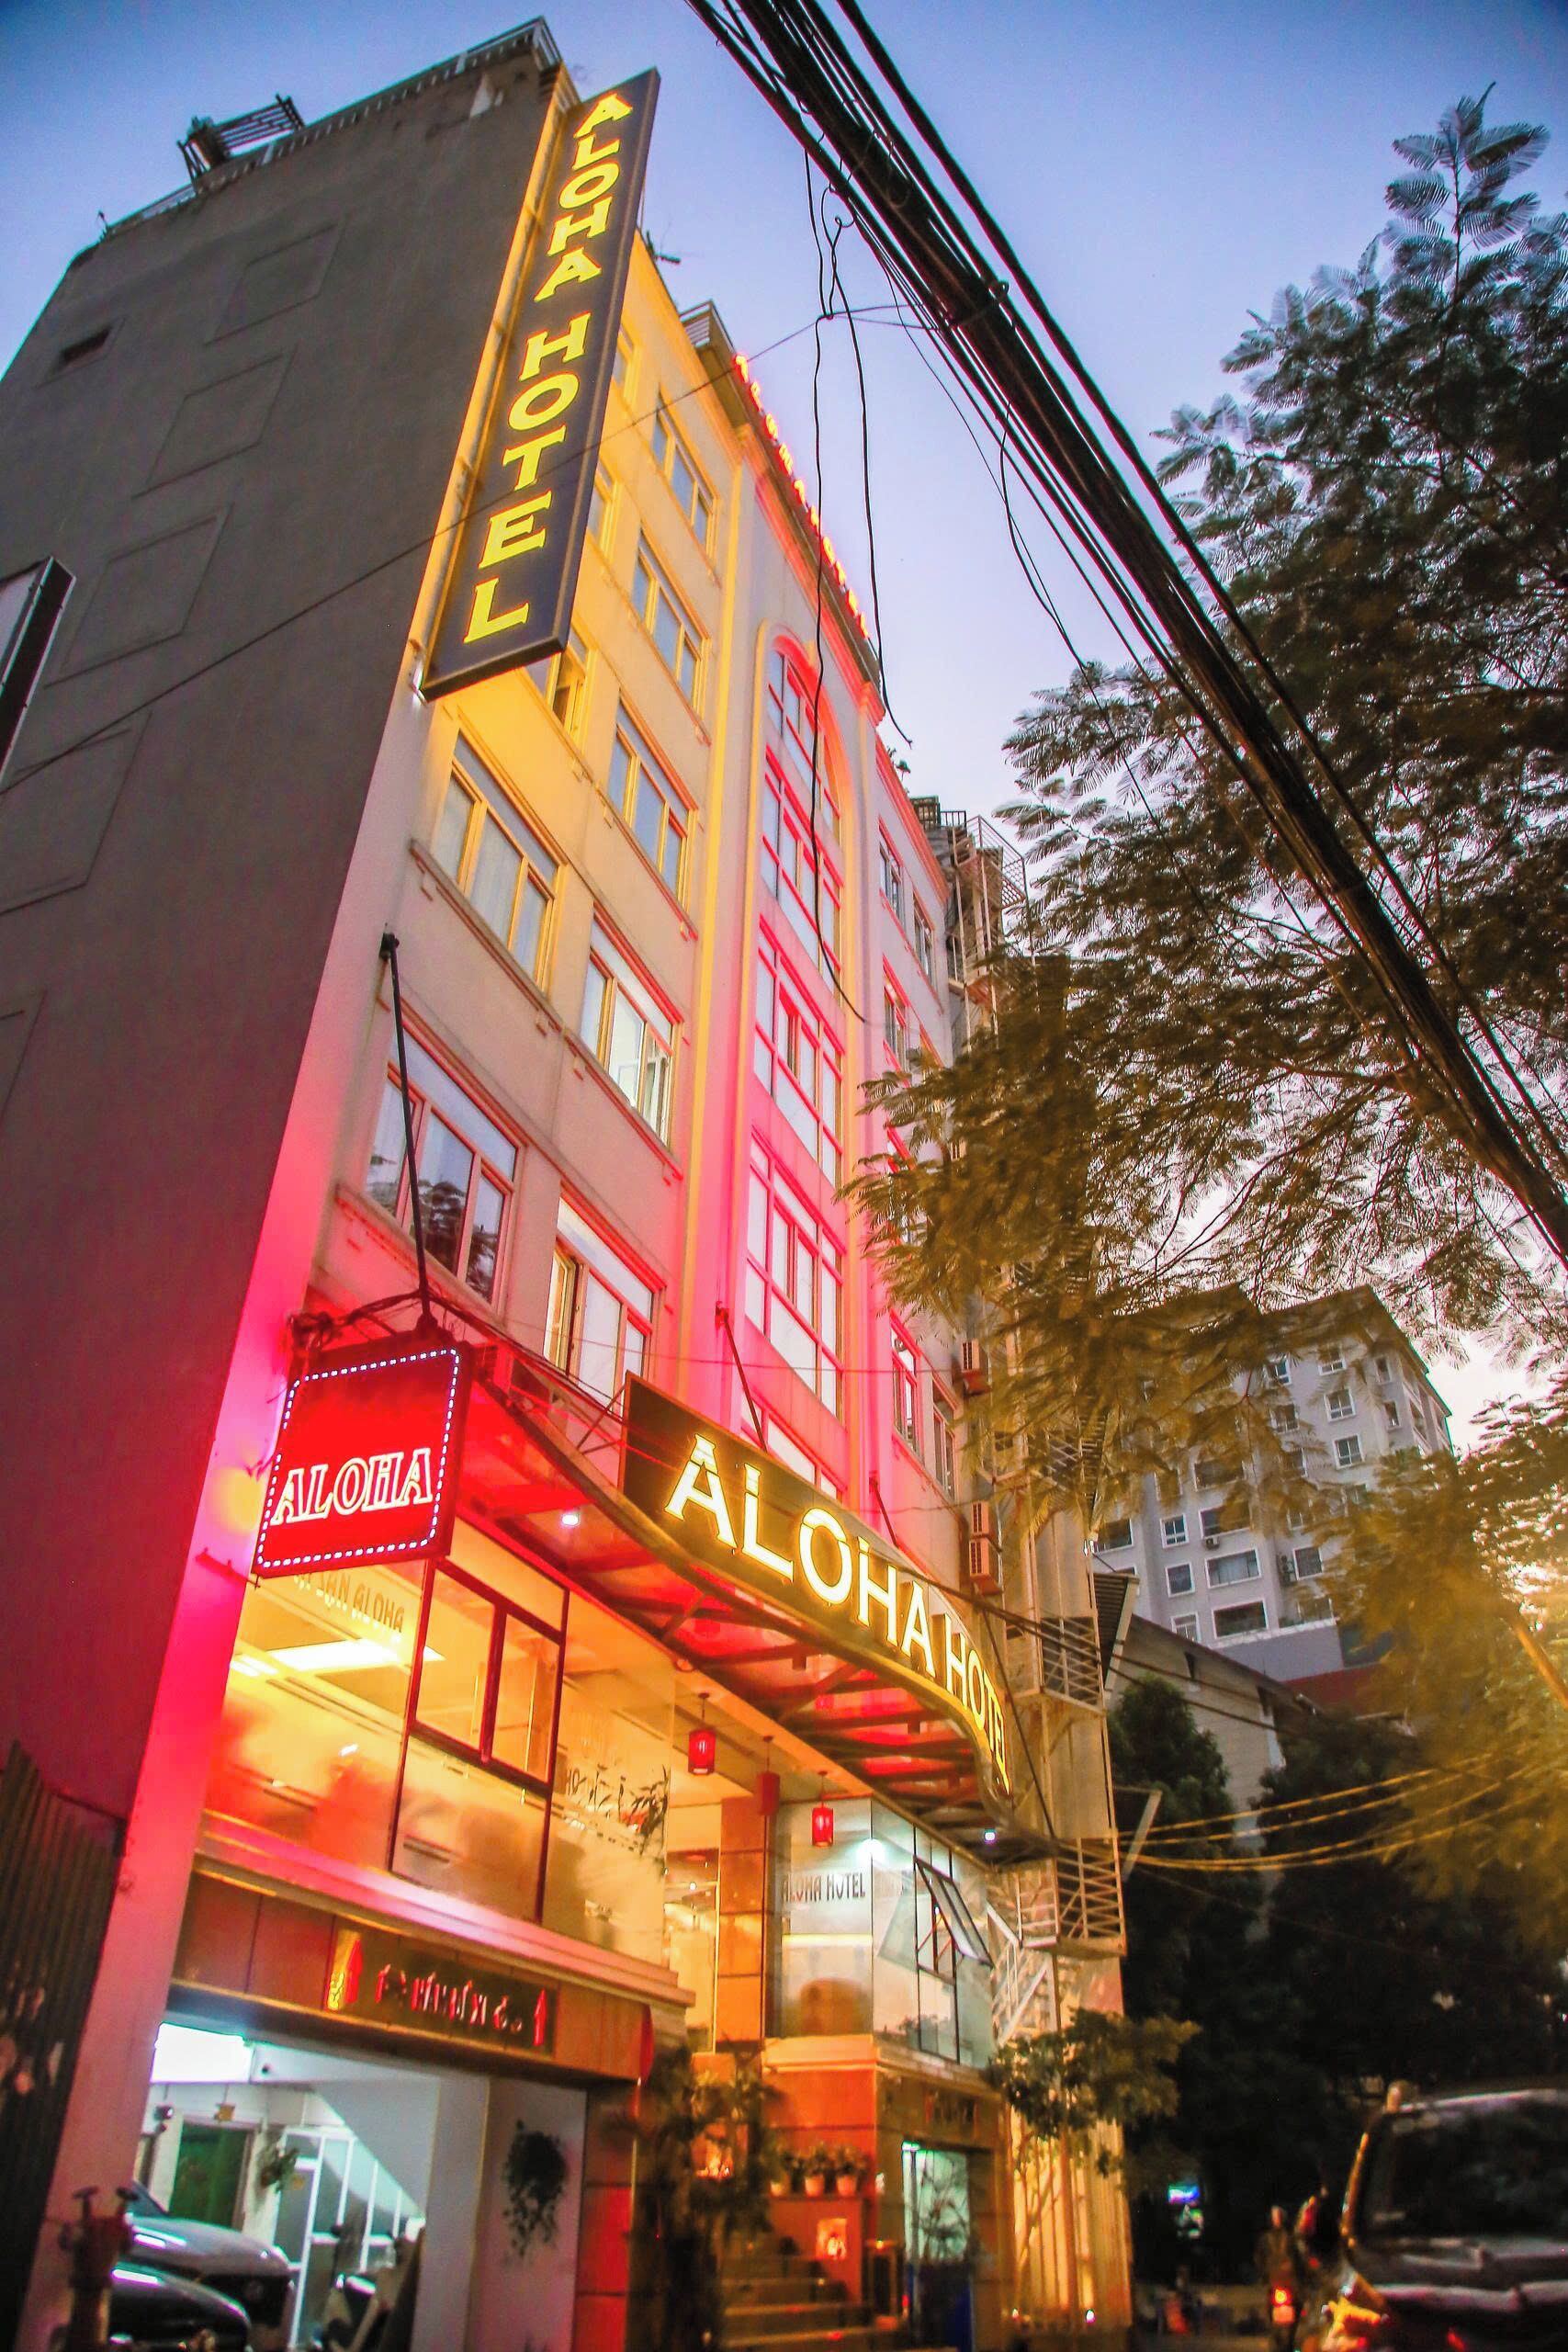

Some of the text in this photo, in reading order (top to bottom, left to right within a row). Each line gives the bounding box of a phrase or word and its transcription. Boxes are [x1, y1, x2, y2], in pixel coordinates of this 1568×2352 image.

[462, 91, 634, 644] ALOHA HOTEL
[270, 1447, 433, 1526] ALOHA
[663, 1434, 1012, 1794] ALOHA HOTEL
[827, 1872, 866, 1901] HOTEL
